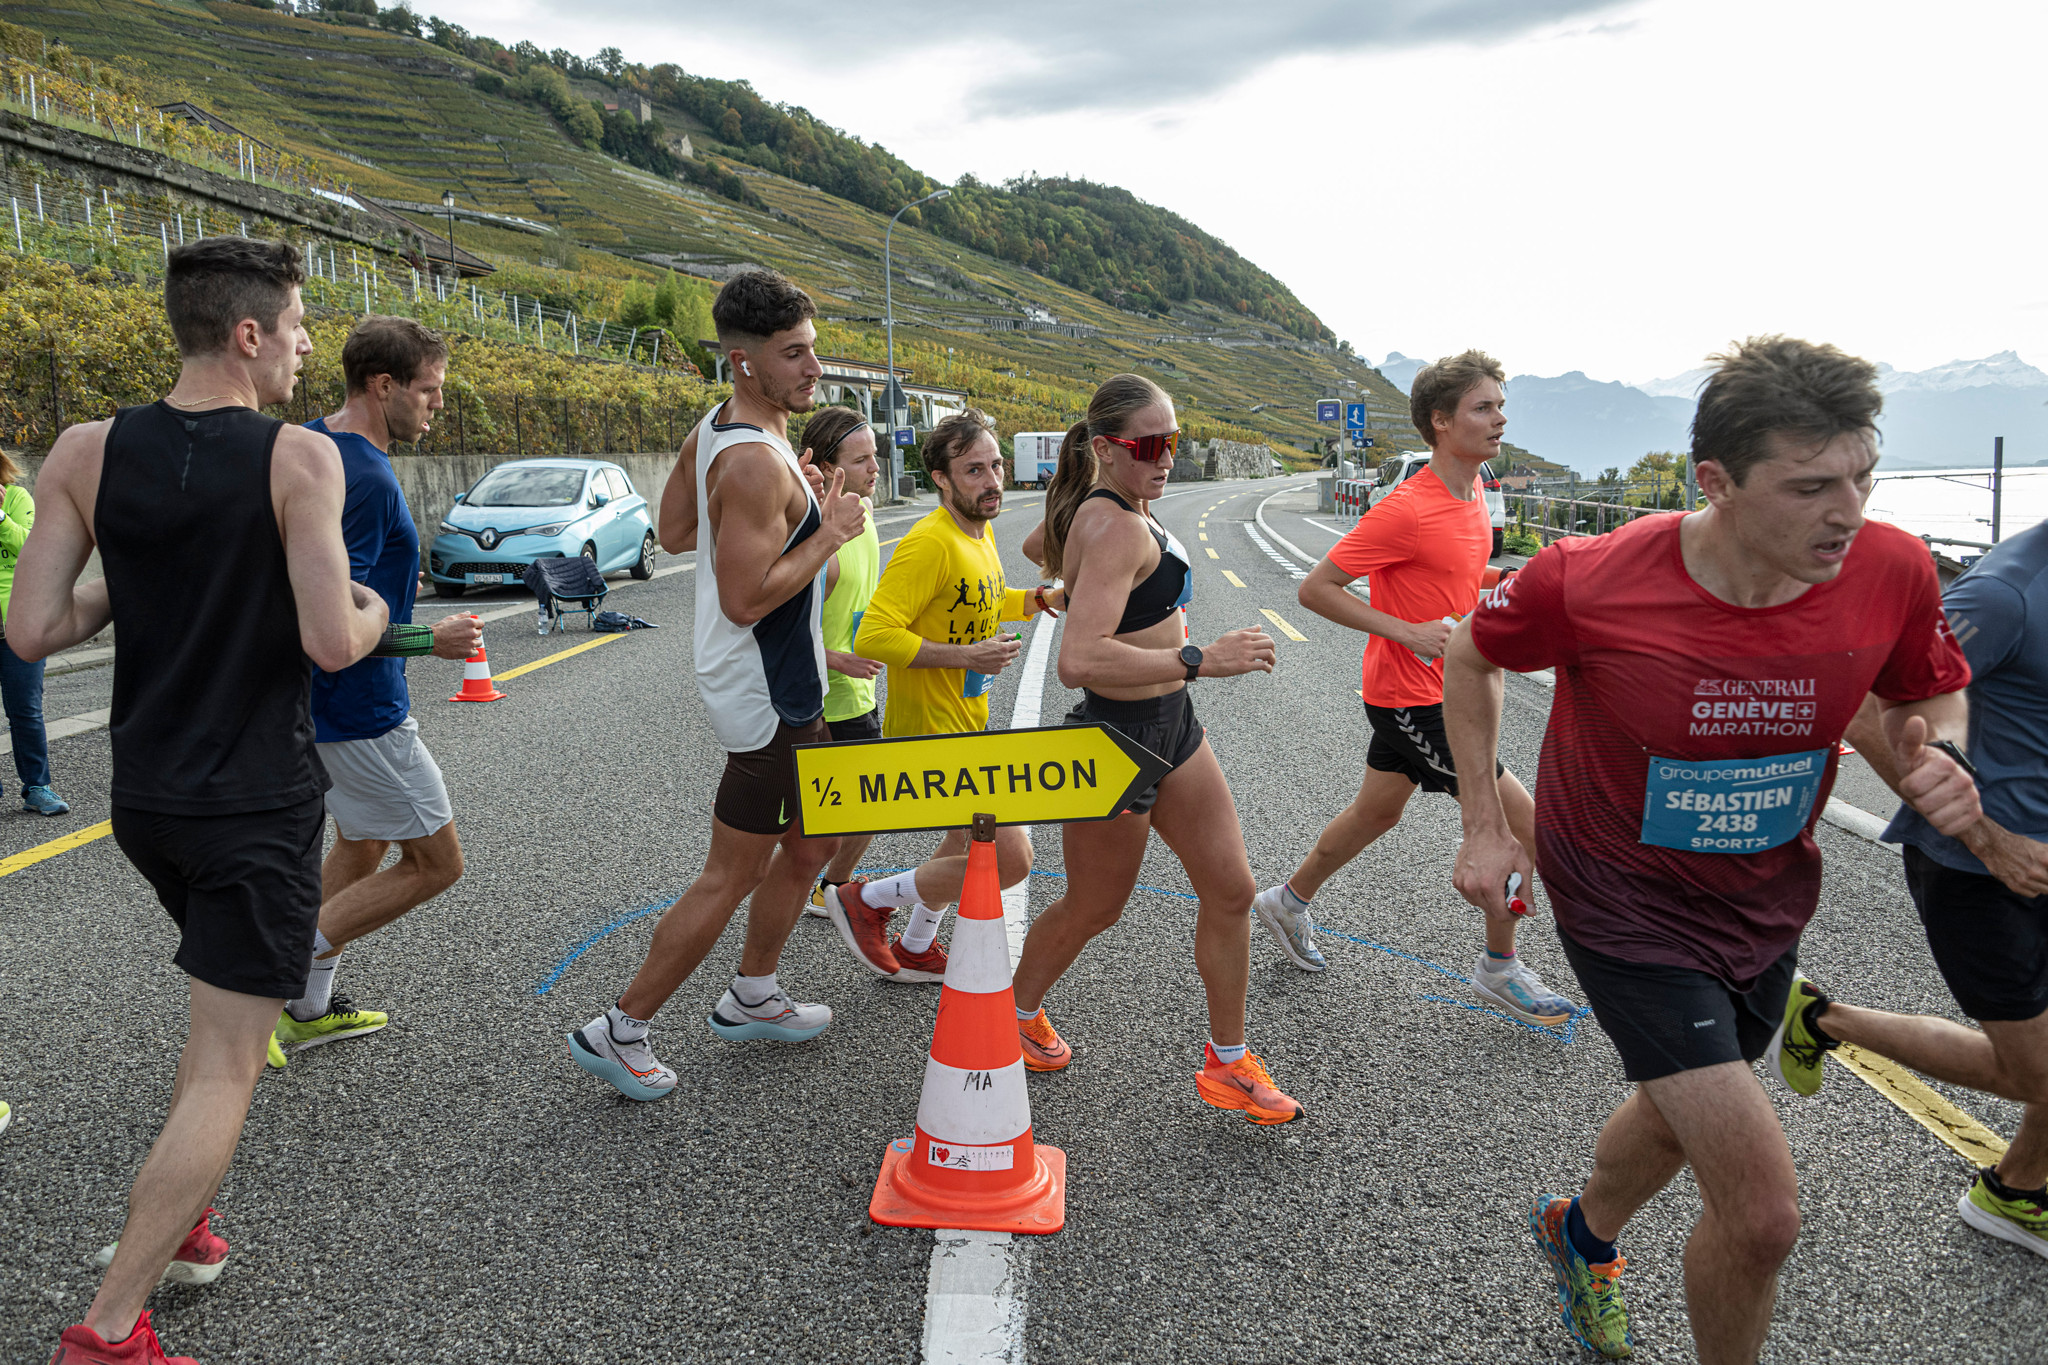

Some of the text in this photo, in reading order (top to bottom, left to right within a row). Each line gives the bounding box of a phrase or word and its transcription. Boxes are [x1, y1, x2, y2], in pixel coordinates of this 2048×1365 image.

[1723, 679, 1815, 696] GENERALI
[1691, 697, 1795, 720] GENÈVE
[1689, 722, 1813, 736] MARATHON
[859, 758, 1097, 803] MARATHON
[1665, 786, 1793, 812] SÉBASTIEN
[1697, 814, 1758, 832] 2438
[963, 1071, 992, 1091] MA
